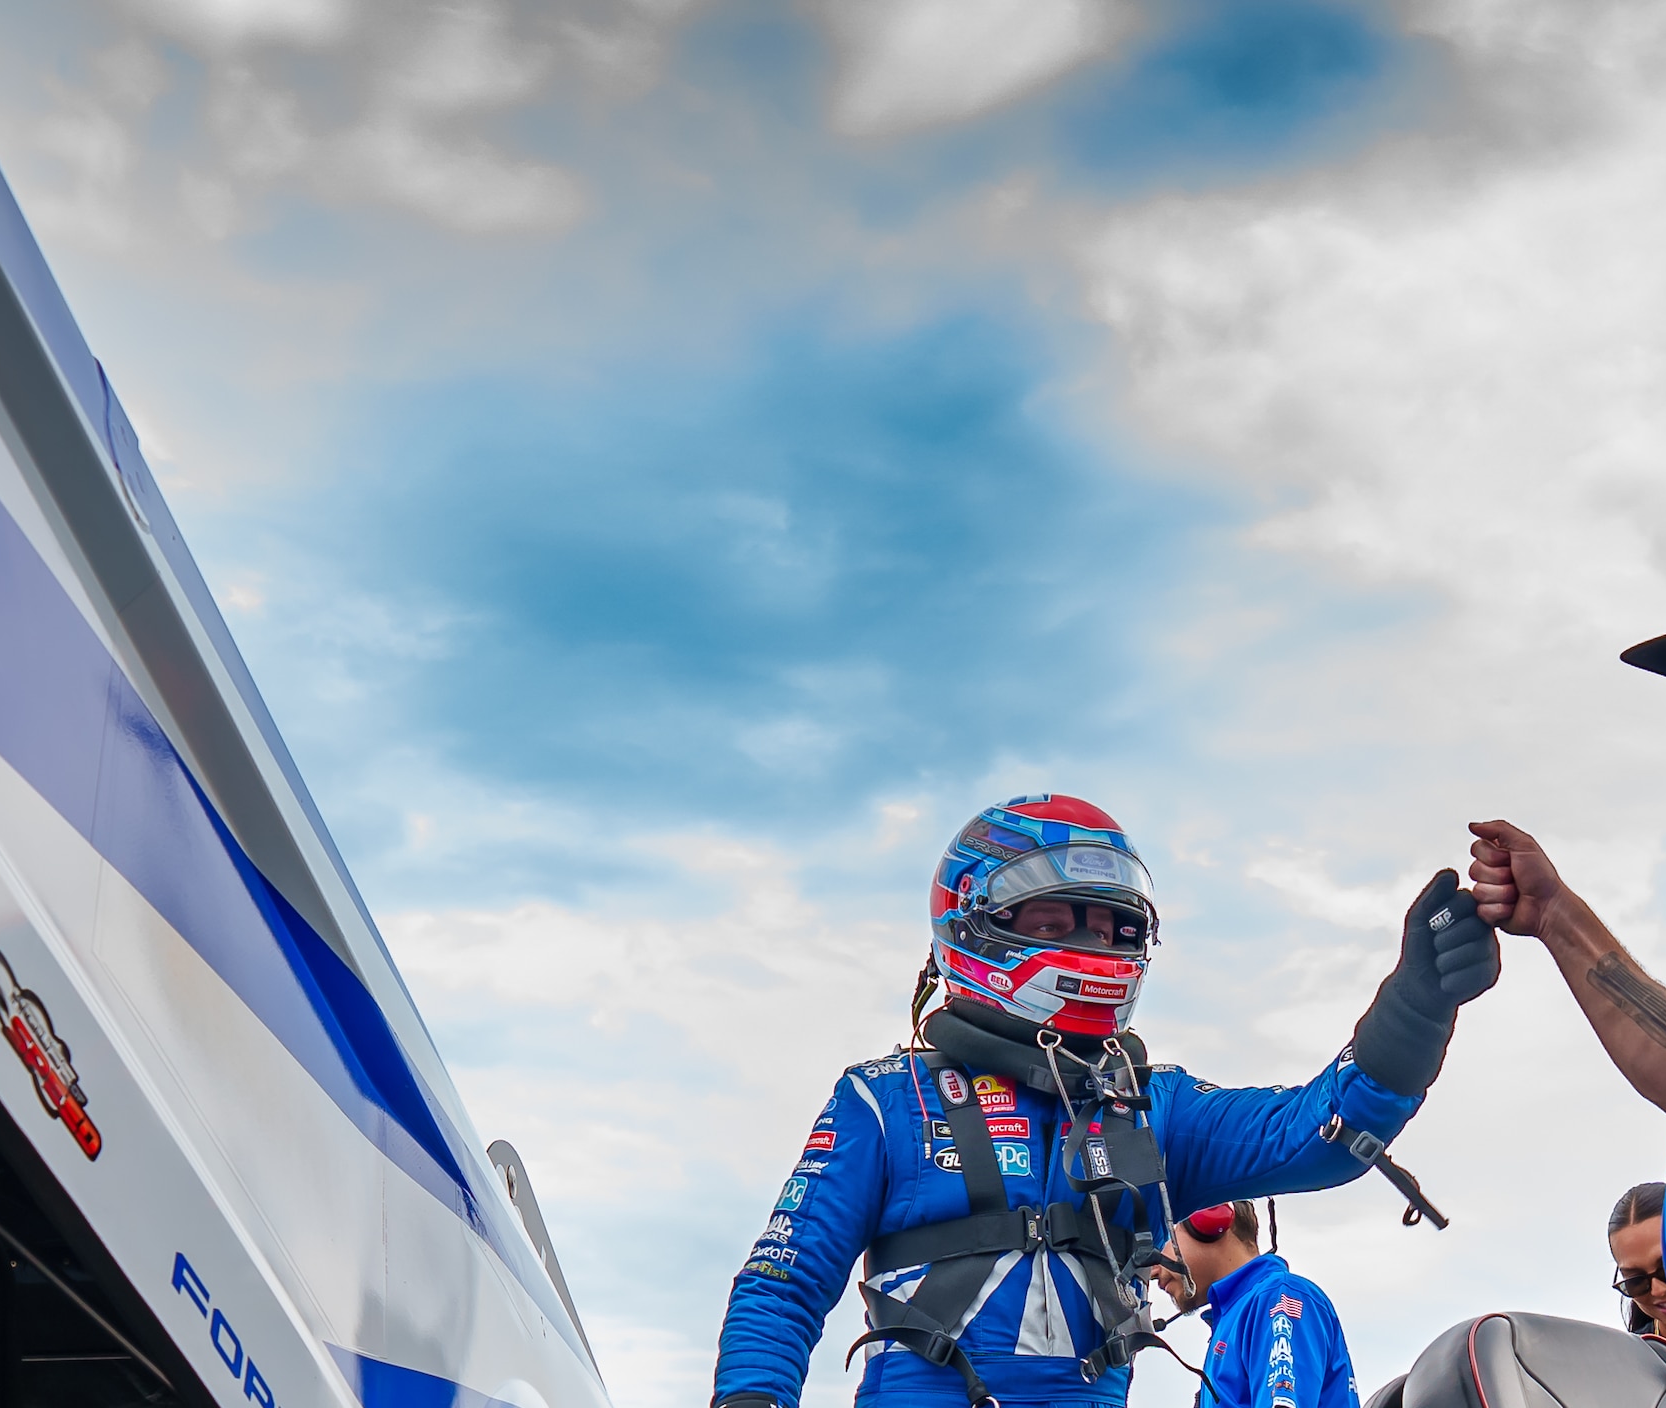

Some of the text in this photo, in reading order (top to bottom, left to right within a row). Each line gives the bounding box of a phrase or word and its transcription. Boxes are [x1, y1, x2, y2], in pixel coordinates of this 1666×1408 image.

[1080, 852, 1108, 867] Ford
[1070, 867, 1116, 880] RACING
[1430, 911, 1452, 931] OMP
[989, 973, 1010, 988] BELL
[1084, 984, 1124, 996] Motorcraft
[945, 1072, 963, 1099] BELL
[978, 1092, 1010, 1105] sion
